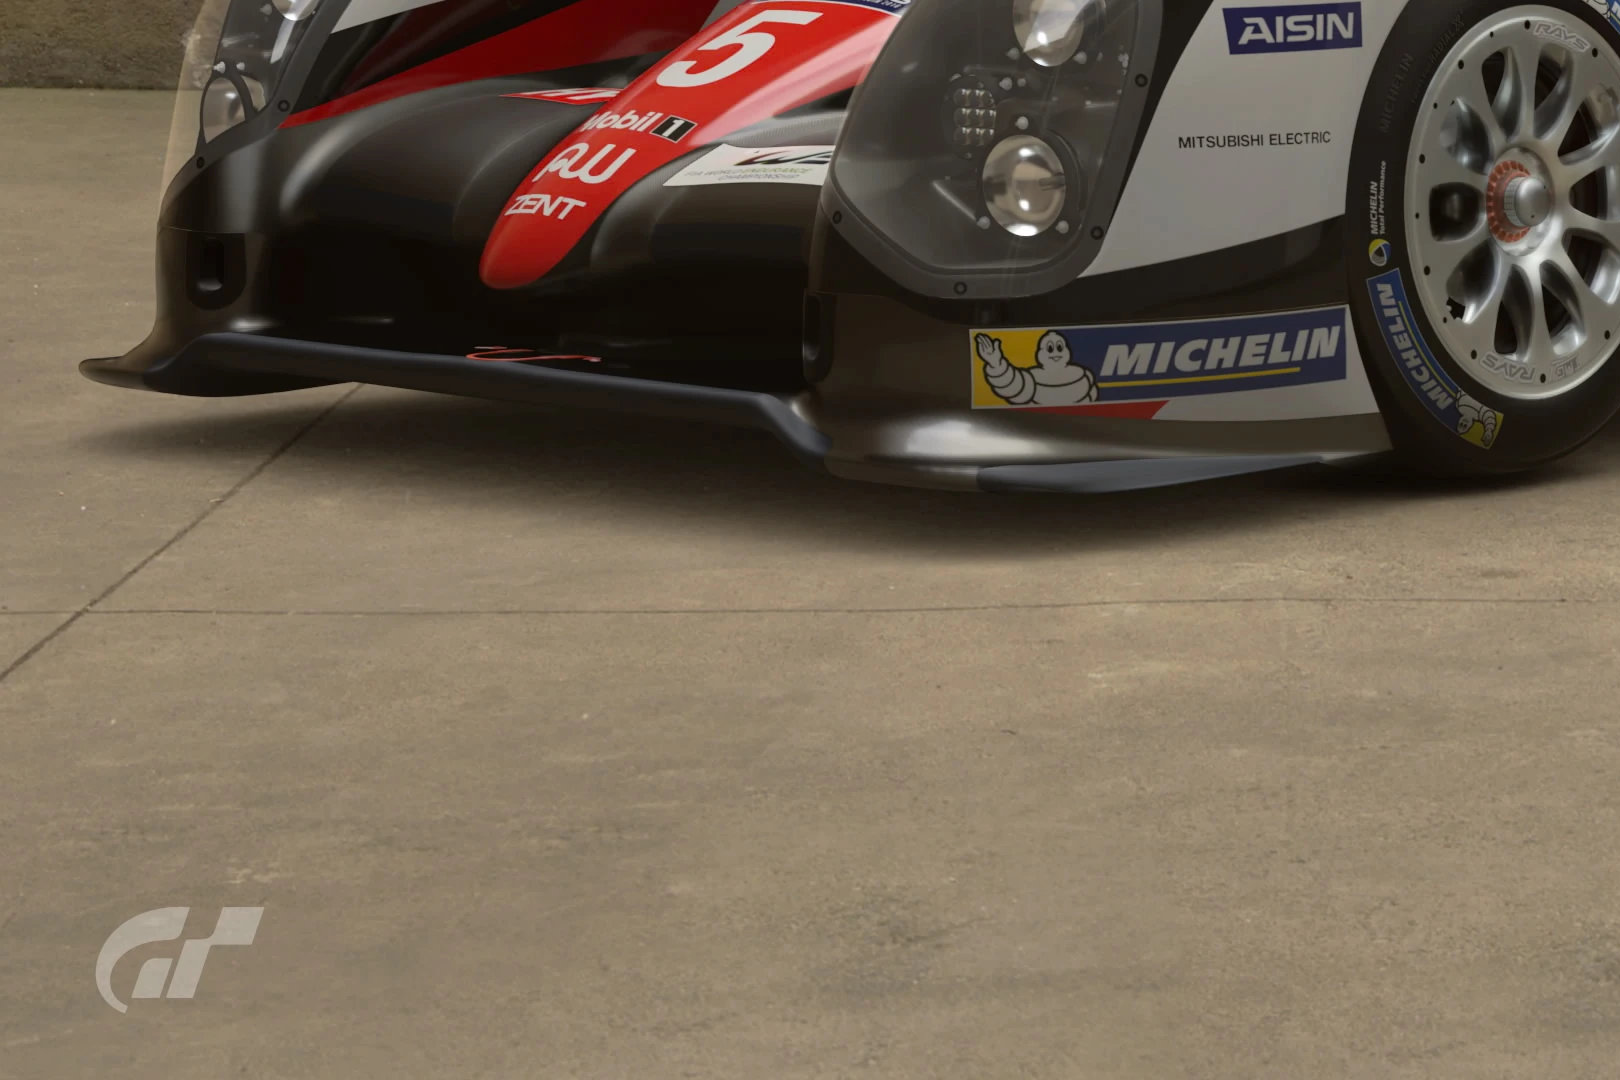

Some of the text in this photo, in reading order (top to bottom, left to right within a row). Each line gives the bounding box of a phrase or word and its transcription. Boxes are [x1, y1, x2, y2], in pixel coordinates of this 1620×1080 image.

[1238, 12, 1354, 45] AISIN
[1534, 22, 1590, 52] RAYS
[655, 9, 823, 88] 5
[580, 110, 689, 140] Mobil 1
[1177, 131, 1331, 149] MITSUBISHI ELECTRIC
[1379, 161, 1387, 208] Performance
[504, 193, 587, 220] ZENT
[1370, 181, 1379, 236] MICHELIN
[1101, 323, 1342, 377] MICHELIN
[1376, 283, 1454, 410] MICHELIN
[1481, 352, 1536, 383] RAYS
